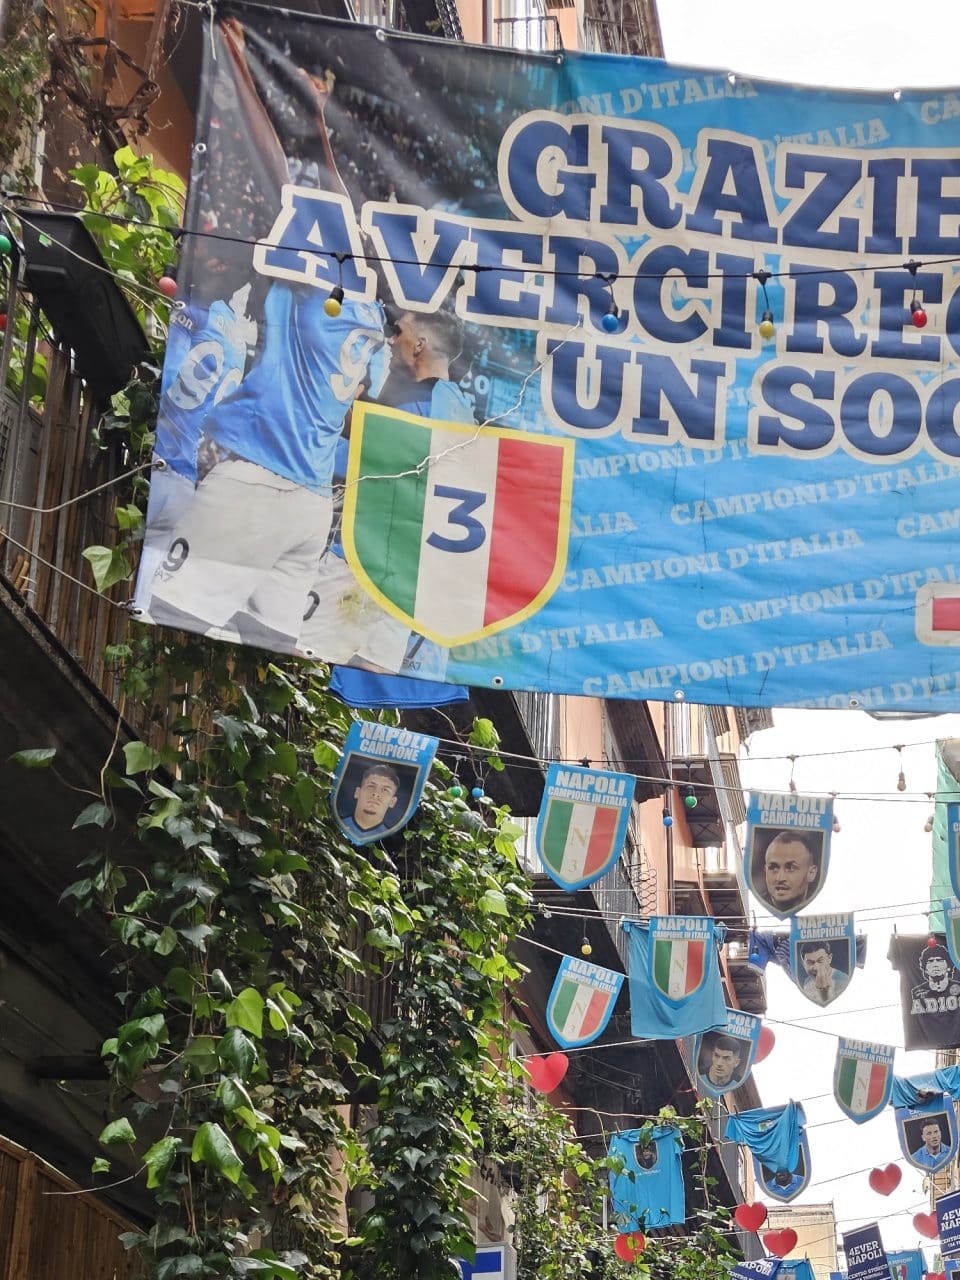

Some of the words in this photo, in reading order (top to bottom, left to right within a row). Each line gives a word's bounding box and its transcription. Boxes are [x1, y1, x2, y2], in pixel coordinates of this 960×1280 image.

[263, 193, 757, 349] AVERCI
[547, 340, 727, 441] UN
[671, 484, 831, 525] CAMPIONI
[426, 485, 487, 554] 3
[560, 549, 722, 593] CAMPIONI
[729, 527, 865, 569] D'ITALIA
[696, 579, 858, 631] CAMPIONI
[583, 654, 750, 698] CAMPIONI
[755, 629, 894, 673] D'ITALIA
[359, 722, 430, 751] NAPOLI
[359, 739, 420, 762] CAMPIONE
[555, 770, 627, 796] NAPOLI
[547, 785, 590, 803] CAMPIONE
[601, 793, 628, 808] ITALIA
[757, 792, 827, 814] NAPOLI
[760, 810, 821, 828] CAMPIONE
[657, 918, 708, 931] NAPOLI
[797, 915, 850, 931] NAPOLI
[800, 926, 847, 940] CAMPIONE
[568, 960, 619, 986] NAPOLI
[848, 1249, 883, 1266] NAPOLI
[849, 1240, 880, 1257] 4EVER
